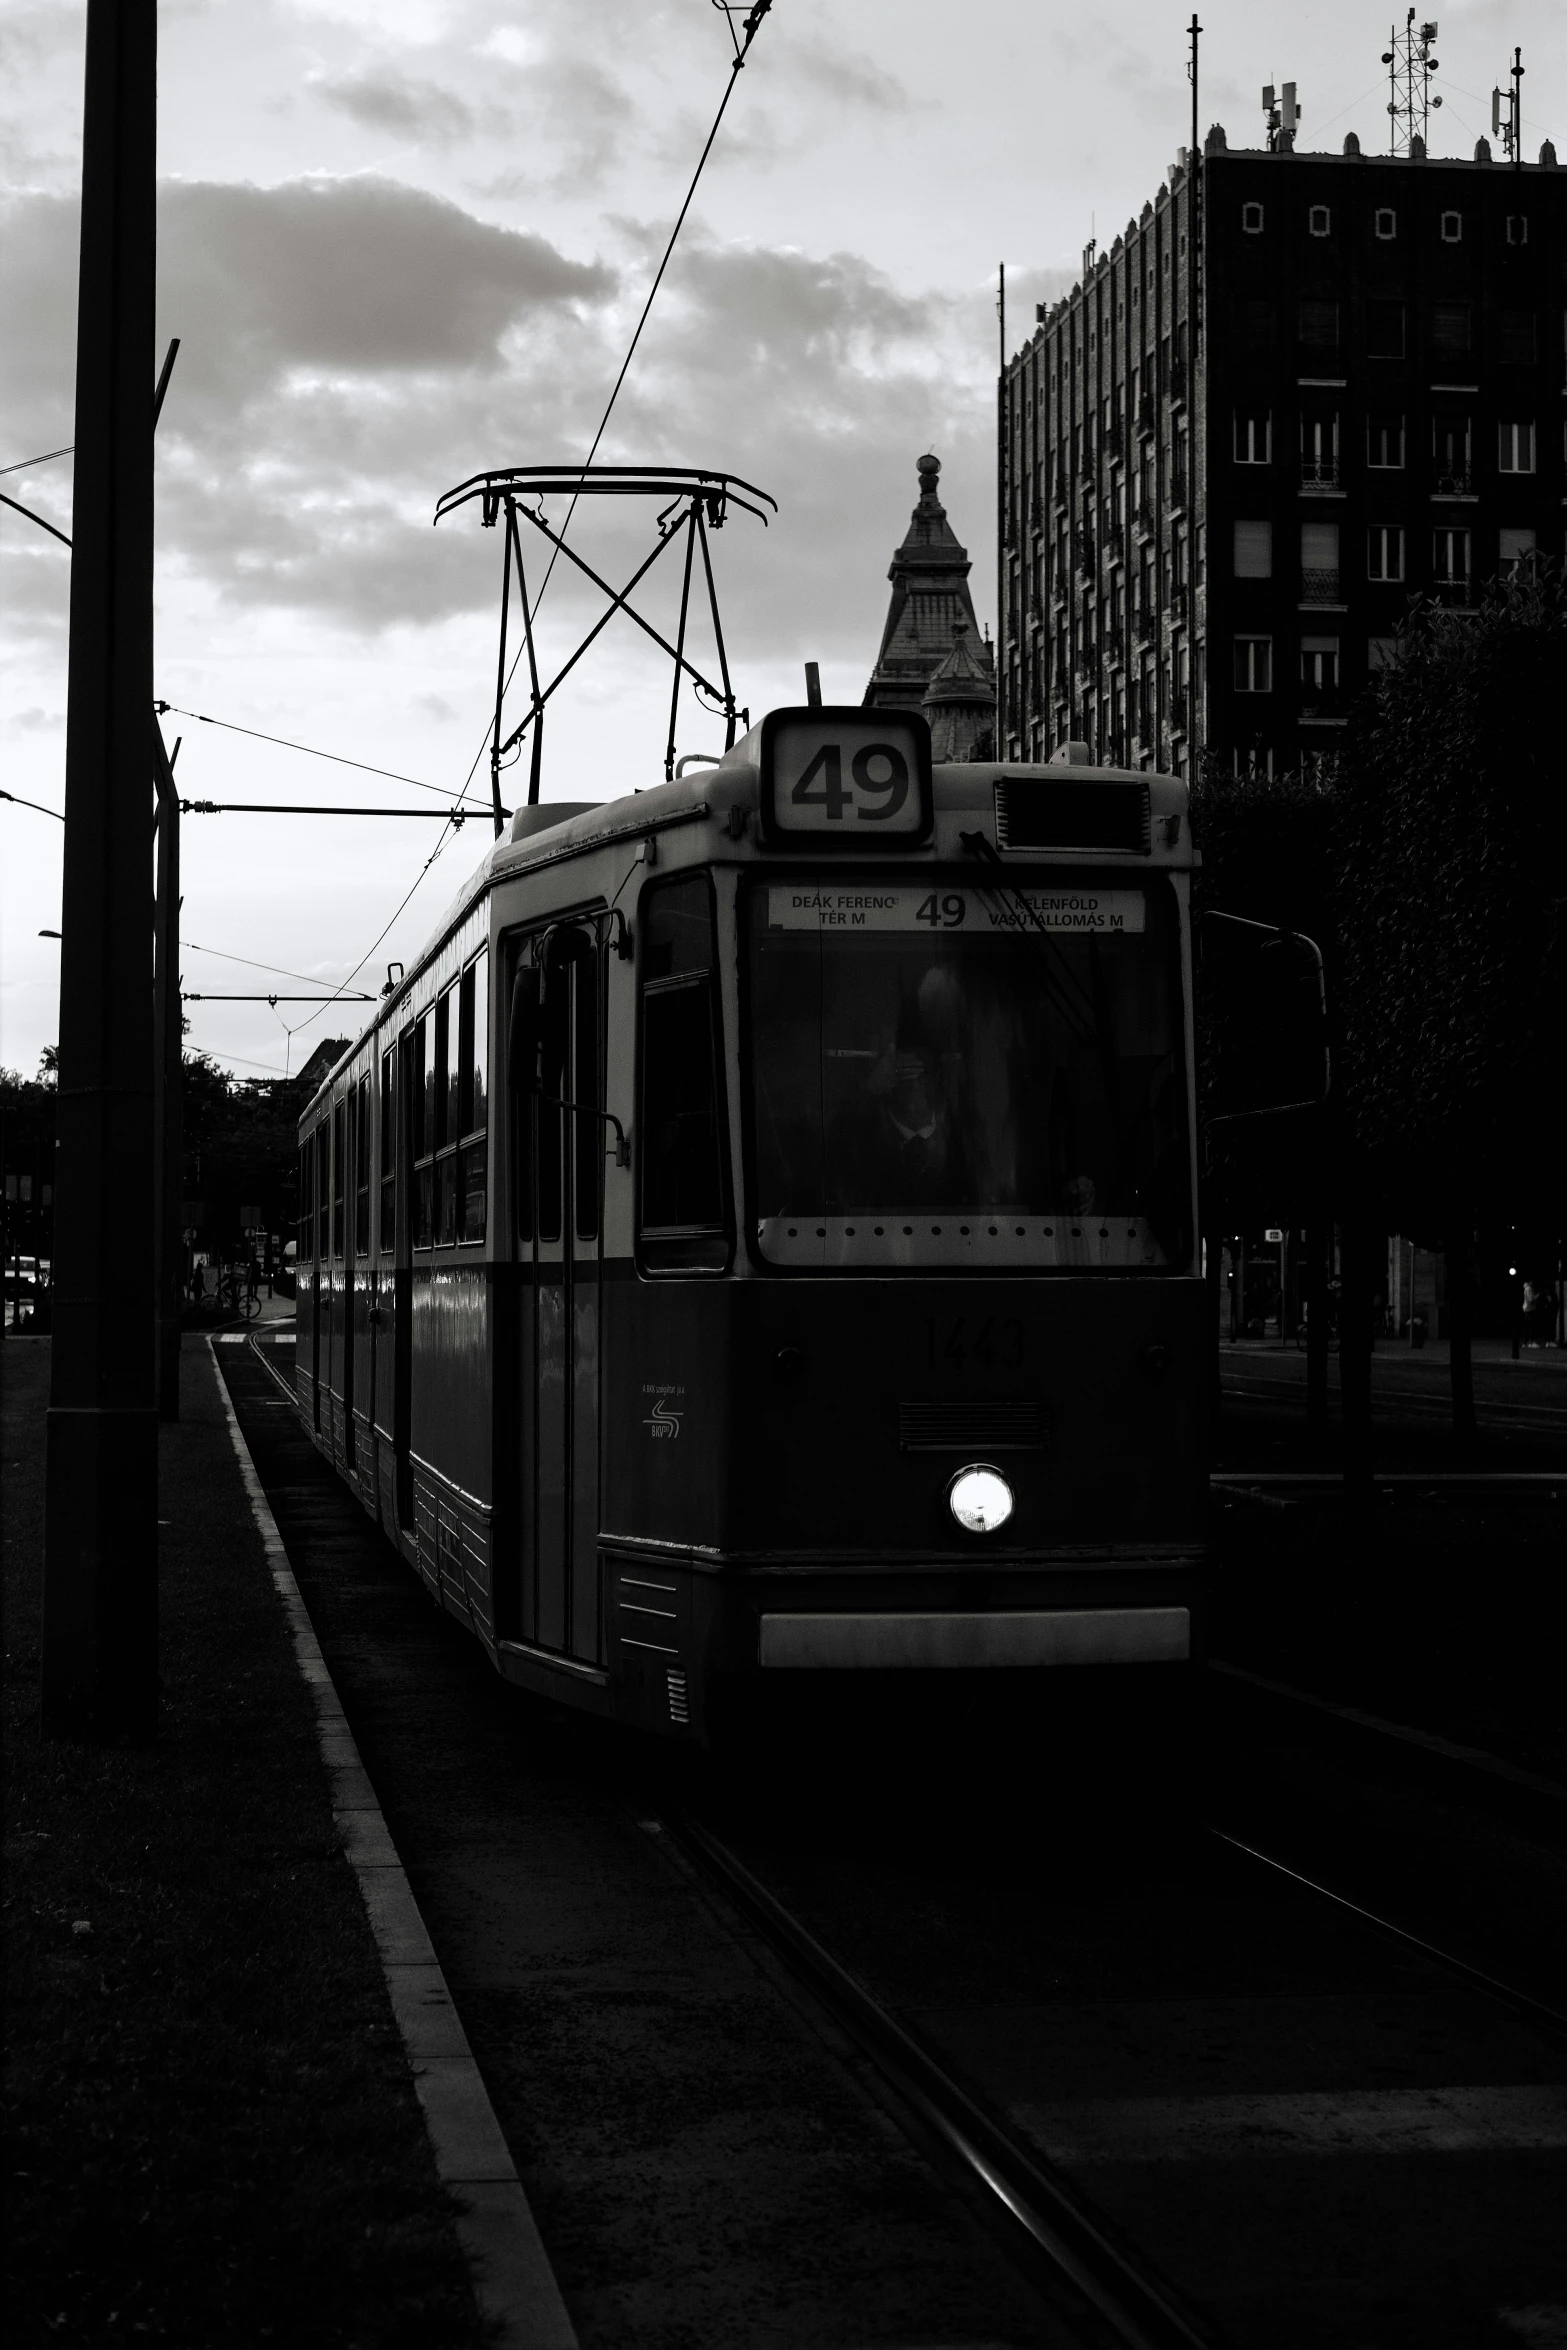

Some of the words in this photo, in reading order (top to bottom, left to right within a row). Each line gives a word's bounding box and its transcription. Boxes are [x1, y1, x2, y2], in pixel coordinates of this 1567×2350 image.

[792, 743, 909, 820] 49
[793, 893, 832, 908] DEÁK
[837, 896, 894, 909] FERENC
[1014, 895, 1098, 910] KELENFÖLD
[820, 910, 847, 925] TÉR
[851, 913, 866, 925] M
[915, 894, 966, 928] 49
[1110, 914, 1124, 927] M
[923, 1315, 1026, 1372] 1443
